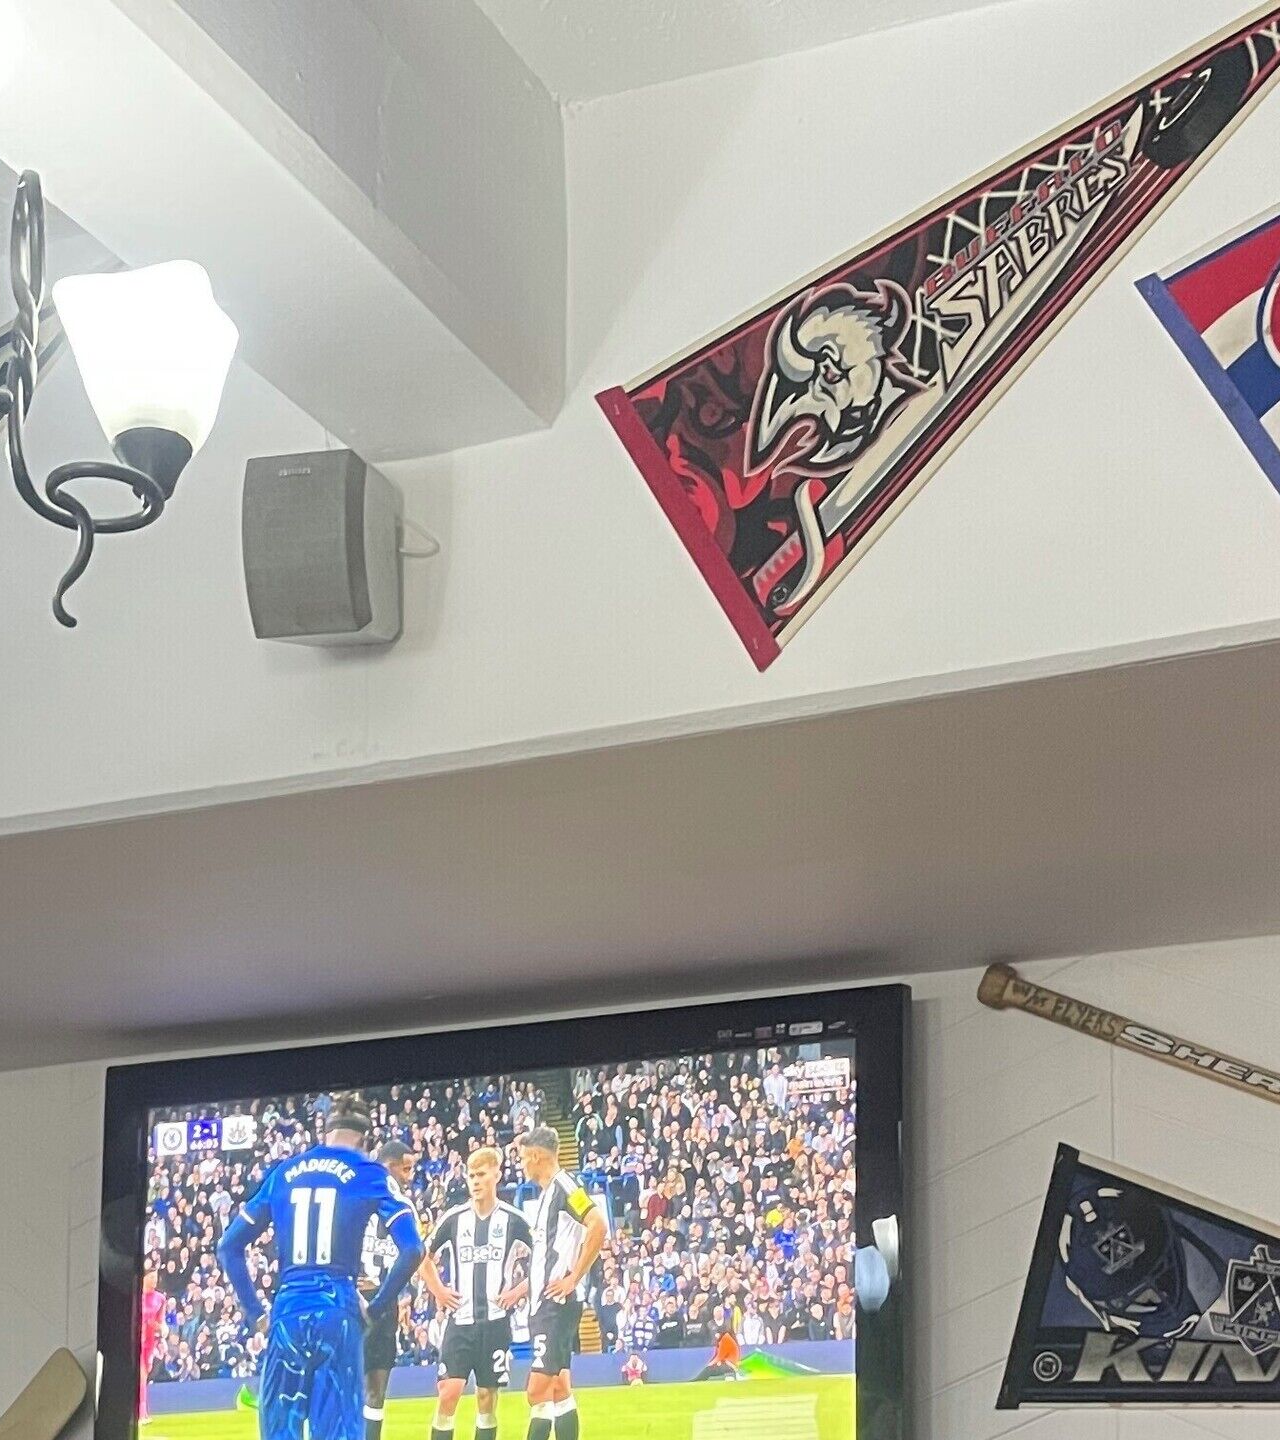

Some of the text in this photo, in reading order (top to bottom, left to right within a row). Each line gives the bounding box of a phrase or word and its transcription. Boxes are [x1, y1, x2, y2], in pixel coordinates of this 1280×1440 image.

[924, 120, 1122, 297] BUFFALO
[926, 146, 1133, 388] SABRES
[283, 1157, 357, 1184] MADUEKE
[290, 1187, 337, 1265] 11
